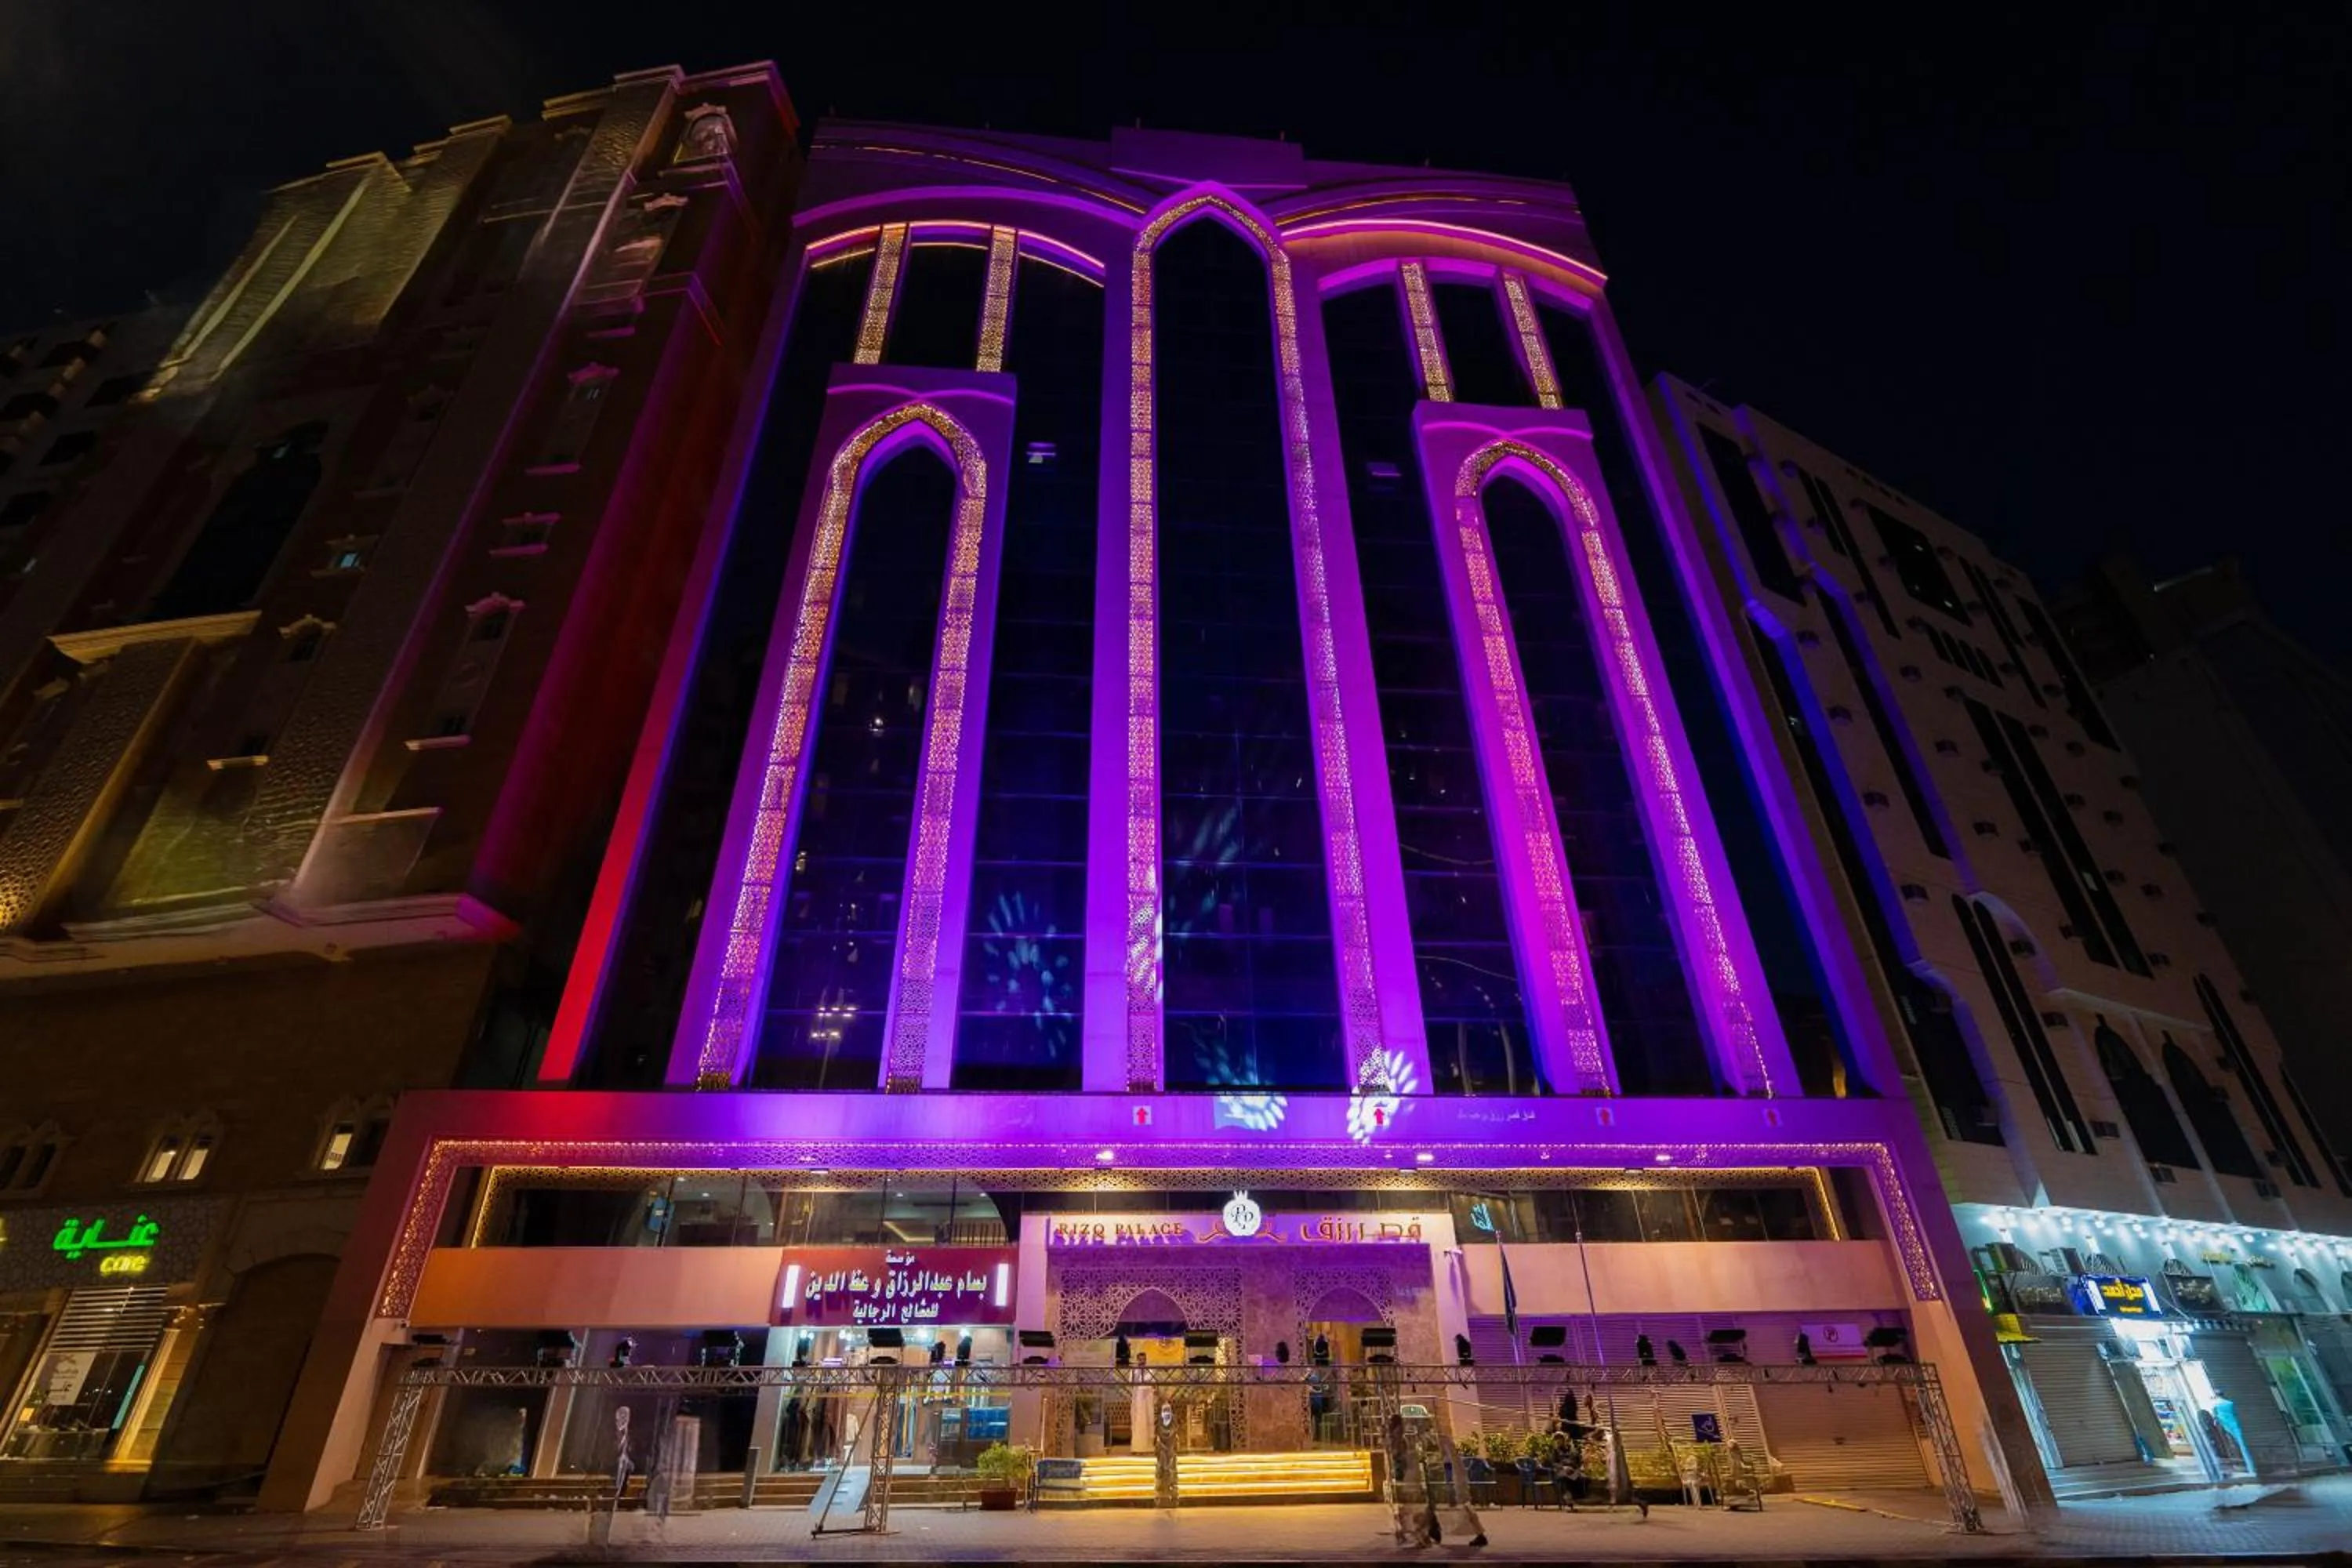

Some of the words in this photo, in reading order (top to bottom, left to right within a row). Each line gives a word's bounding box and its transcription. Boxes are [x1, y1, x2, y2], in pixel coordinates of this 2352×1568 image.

[1058, 1223, 1105, 1240] RIZQ
[1115, 1223, 1183, 1236] PALACE
[1359, 1216, 1421, 1241] قصر
[99, 1254, 148, 1275] care
[805, 1270, 846, 1301] الدين
[956, 1269, 988, 1301] بسام
[851, 1298, 896, 1324] الرجالية
